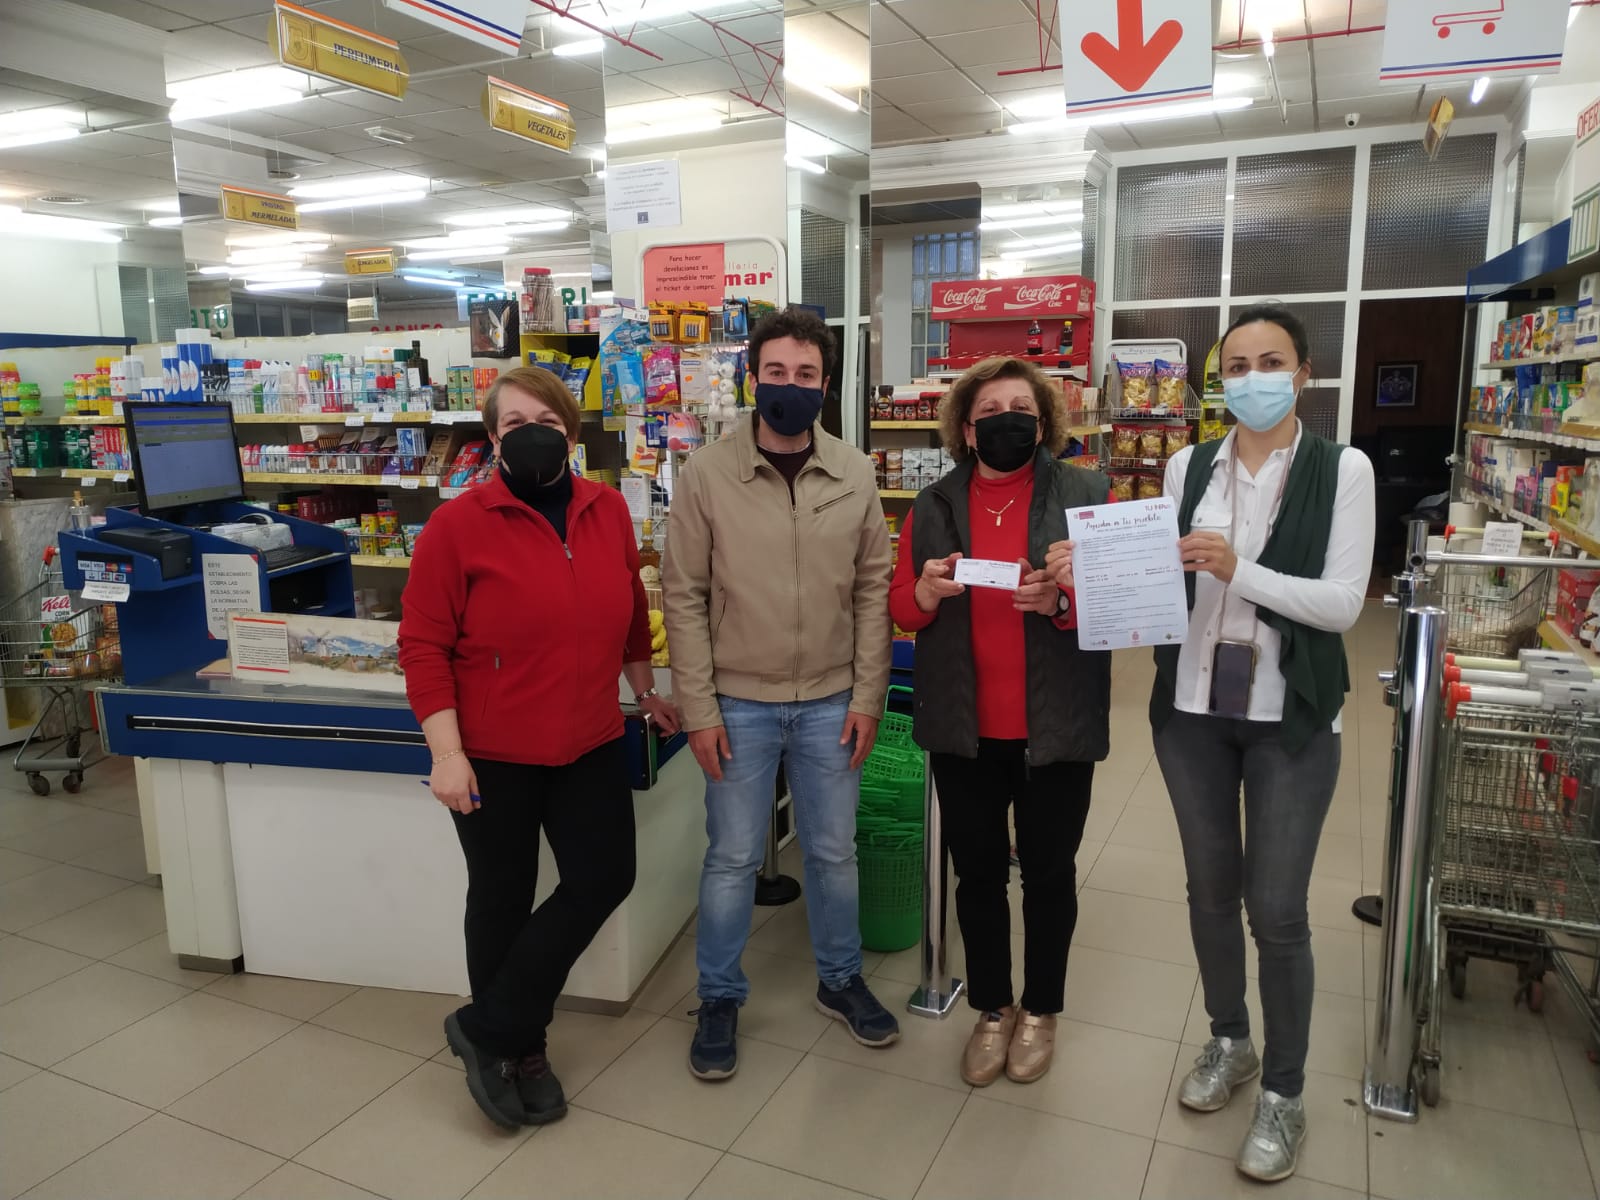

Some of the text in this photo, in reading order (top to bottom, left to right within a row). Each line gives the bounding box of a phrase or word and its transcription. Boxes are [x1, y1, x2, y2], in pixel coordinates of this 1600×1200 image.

[333, 43, 401, 75] PERFUMERIA
[527, 120, 566, 141] VEGETALES
[1577, 102, 1600, 139] OFER
